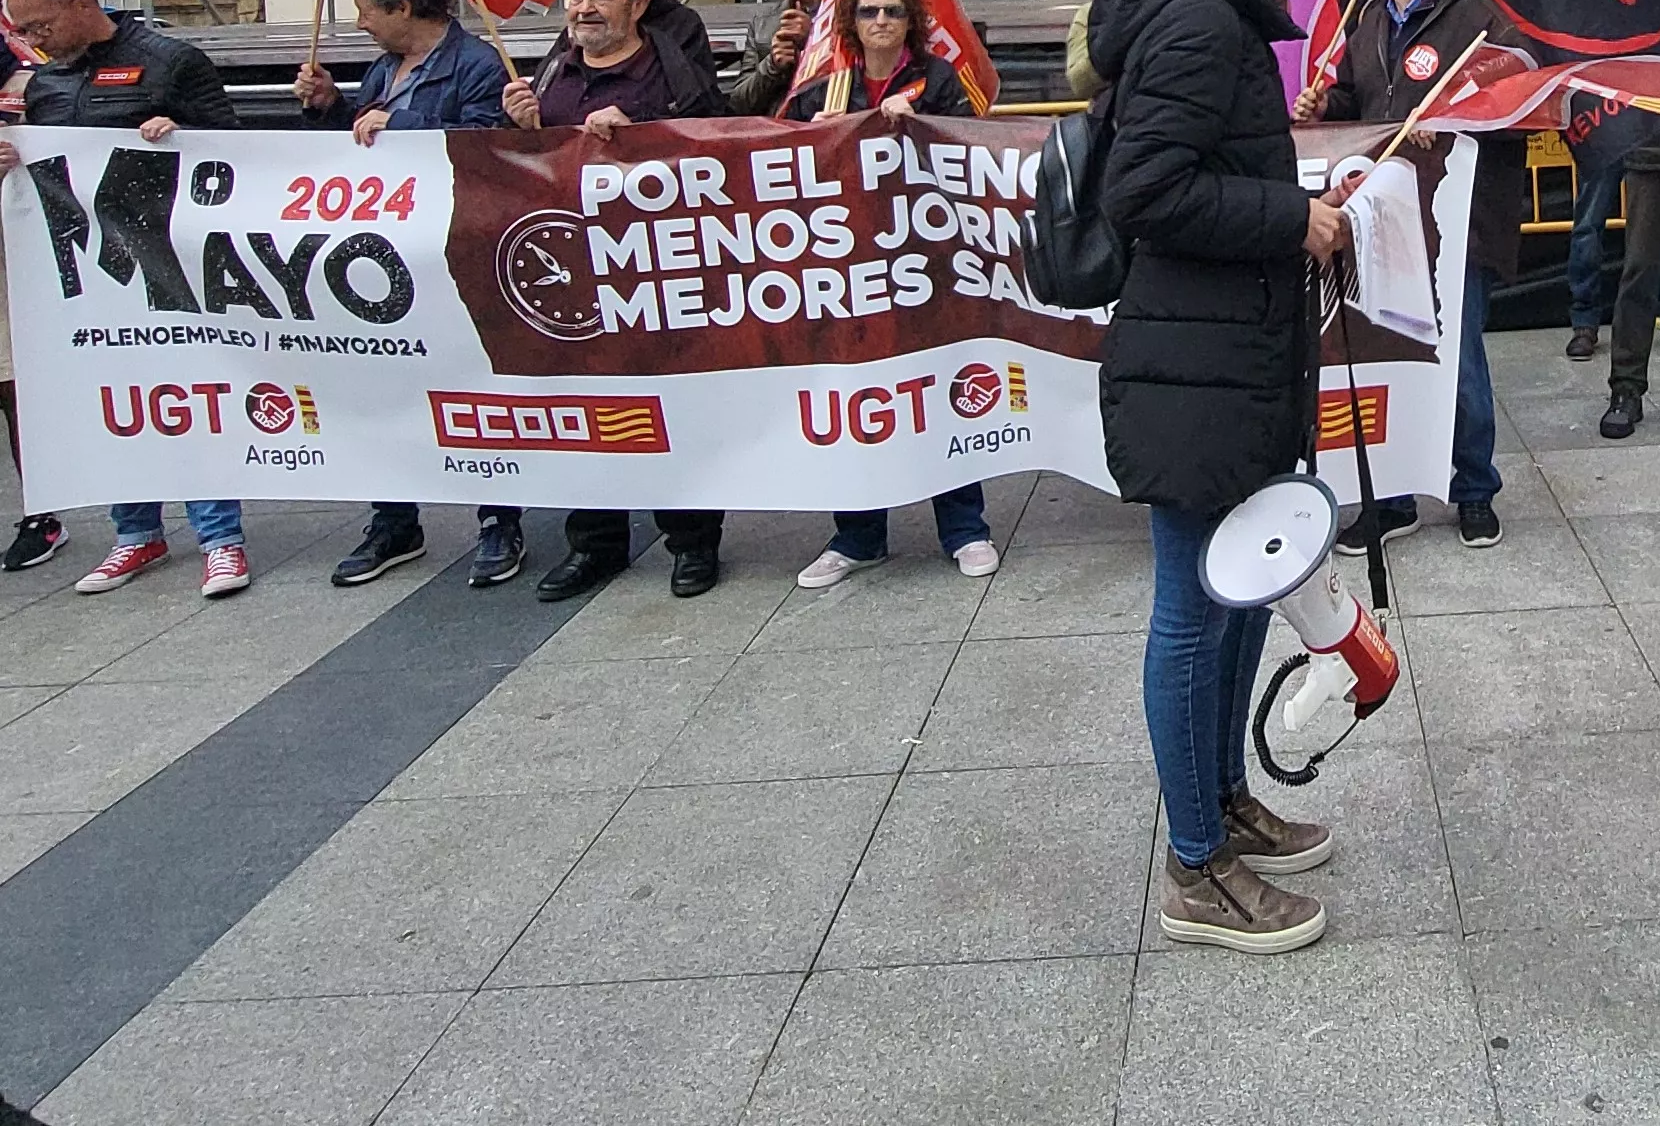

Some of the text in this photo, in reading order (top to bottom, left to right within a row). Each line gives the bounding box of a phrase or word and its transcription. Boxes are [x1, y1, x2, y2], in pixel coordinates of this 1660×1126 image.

[280, 175, 417, 221] 2024
[581, 156, 734, 216] POR
[751, 146, 843, 201] EL
[588, 203, 855, 275] MENOS
[600, 254, 934, 335] MEJORES
[72, 326, 257, 349] #PLENOEMPLEO
[278, 333, 428, 357] #1MAYO2024
[100, 383, 232, 437] UGT
[442, 403, 591, 442] CCOO
[798, 374, 936, 447] UGT
[245, 444, 325, 468] Aragón
[946, 422, 1031, 459] Aragón
[443, 456, 520, 478] Aragón
